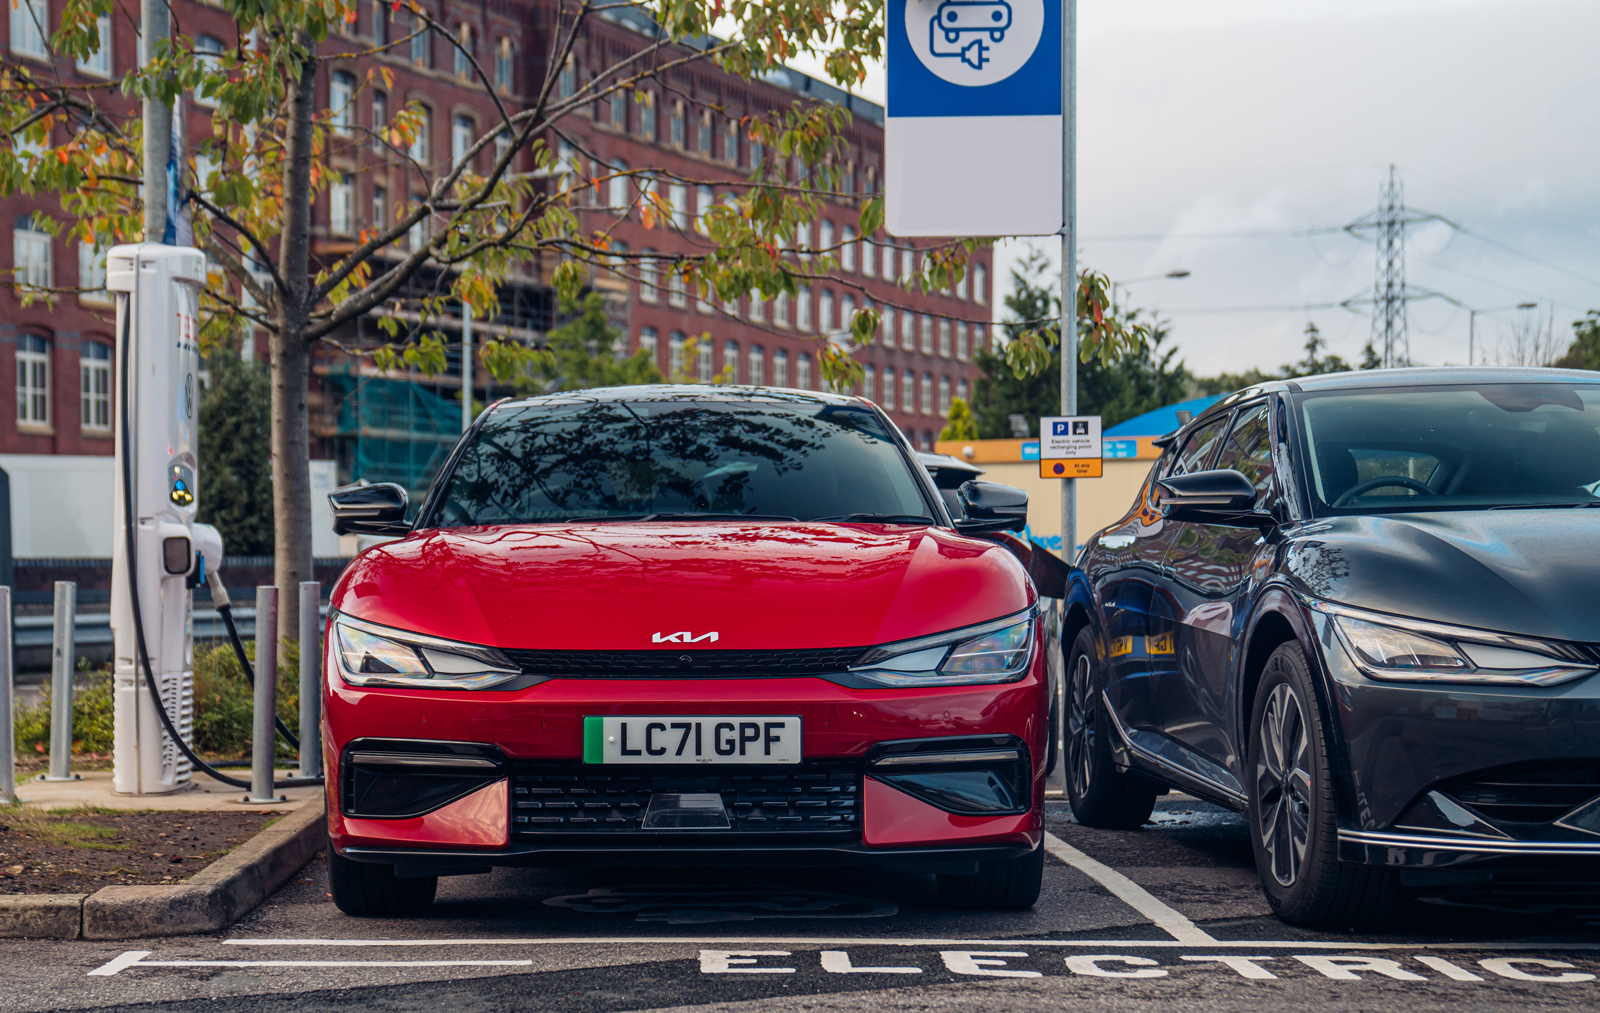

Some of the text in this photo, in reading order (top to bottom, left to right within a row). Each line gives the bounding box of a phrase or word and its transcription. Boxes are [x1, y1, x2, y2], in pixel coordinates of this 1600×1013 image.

[1057, 424, 1065, 434] P
[620, 722, 786, 756] LC71 GPF
[698, 948, 1597, 985] ELECTRIC
